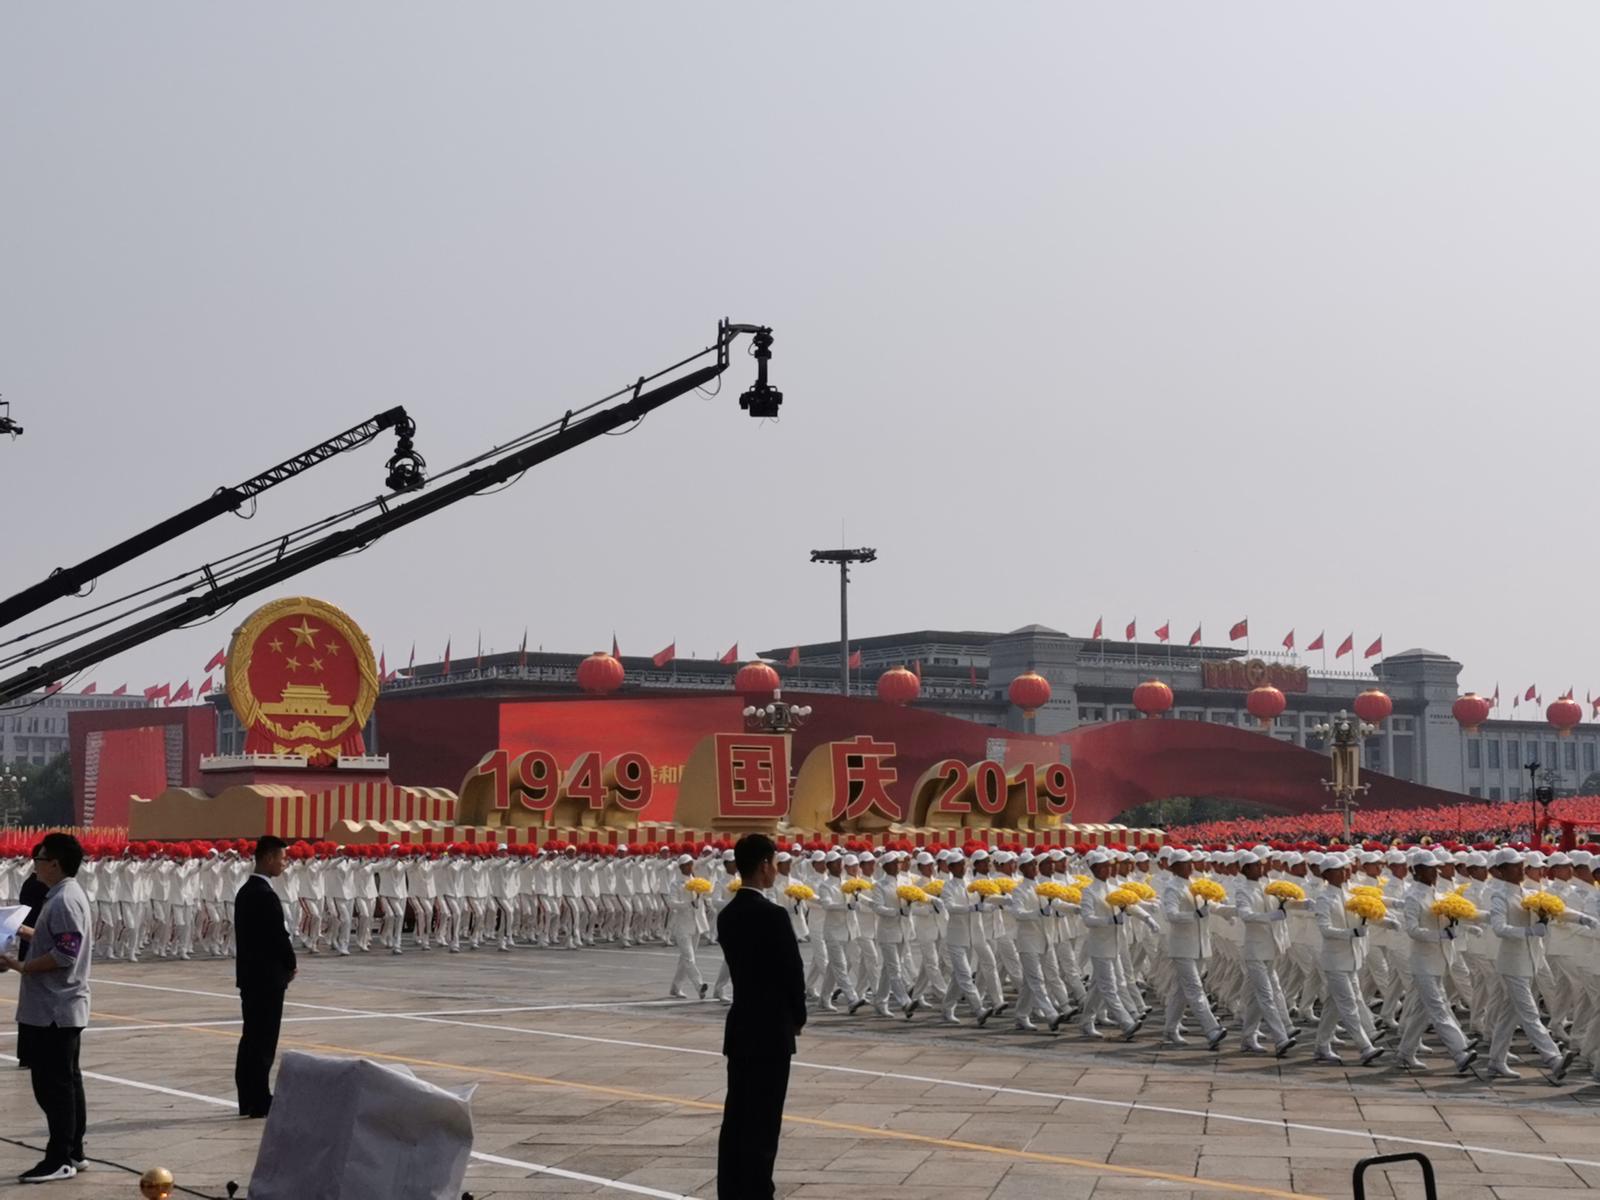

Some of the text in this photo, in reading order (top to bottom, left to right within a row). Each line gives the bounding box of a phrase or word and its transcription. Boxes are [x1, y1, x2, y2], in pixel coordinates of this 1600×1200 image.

[478, 732, 1076, 821] 1949 国庆 2019
